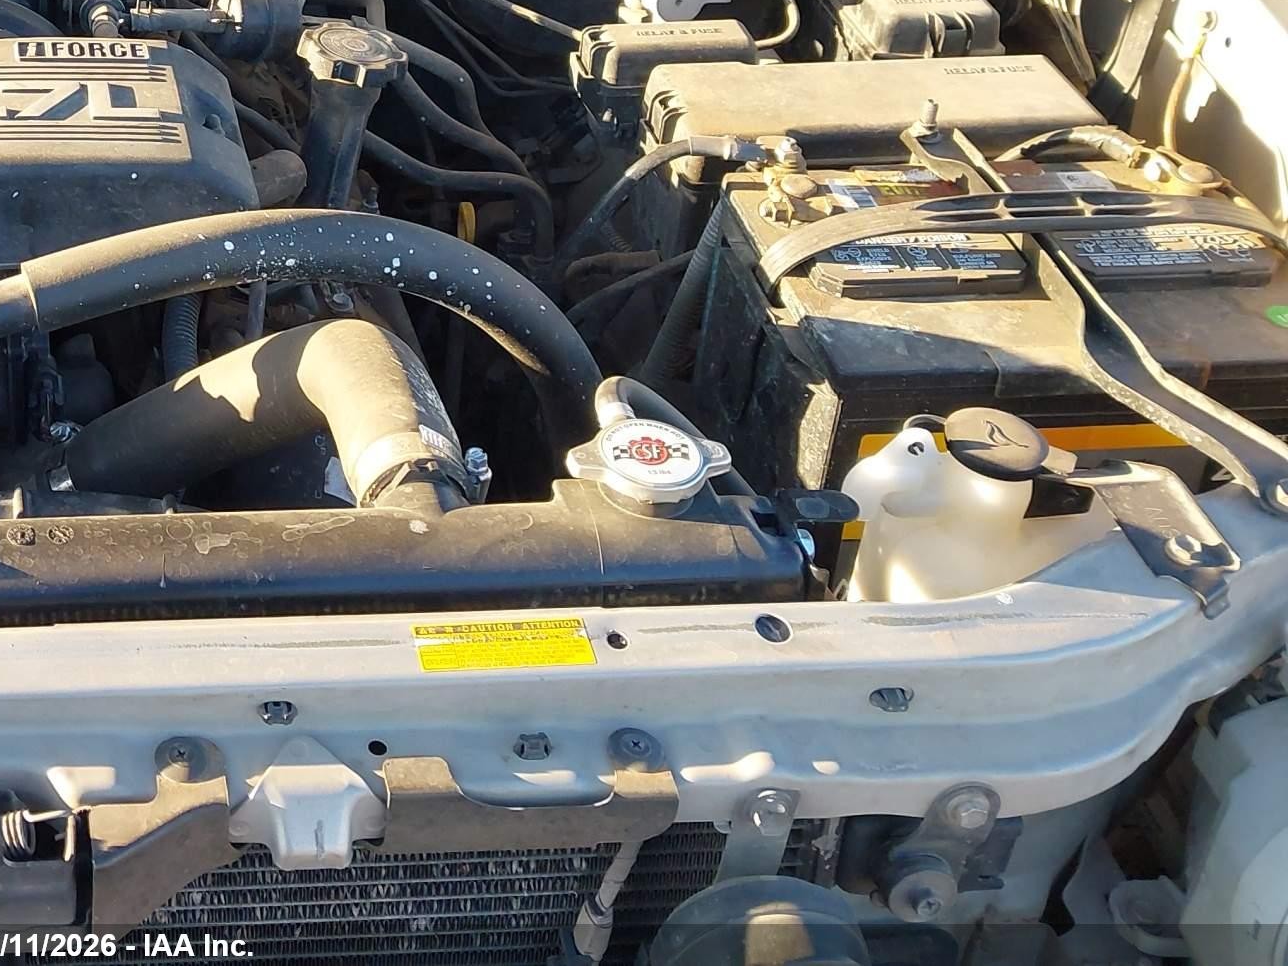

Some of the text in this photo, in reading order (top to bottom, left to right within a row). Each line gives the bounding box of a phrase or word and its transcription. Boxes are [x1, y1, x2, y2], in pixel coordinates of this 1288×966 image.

[636, 29, 675, 37] RELAY
[691, 27, 722, 35] FUSE
[632, 443, 662, 460] CSF
[462, 623, 514, 633] CAUTION
[522, 620, 579, 630] ATTENTION
